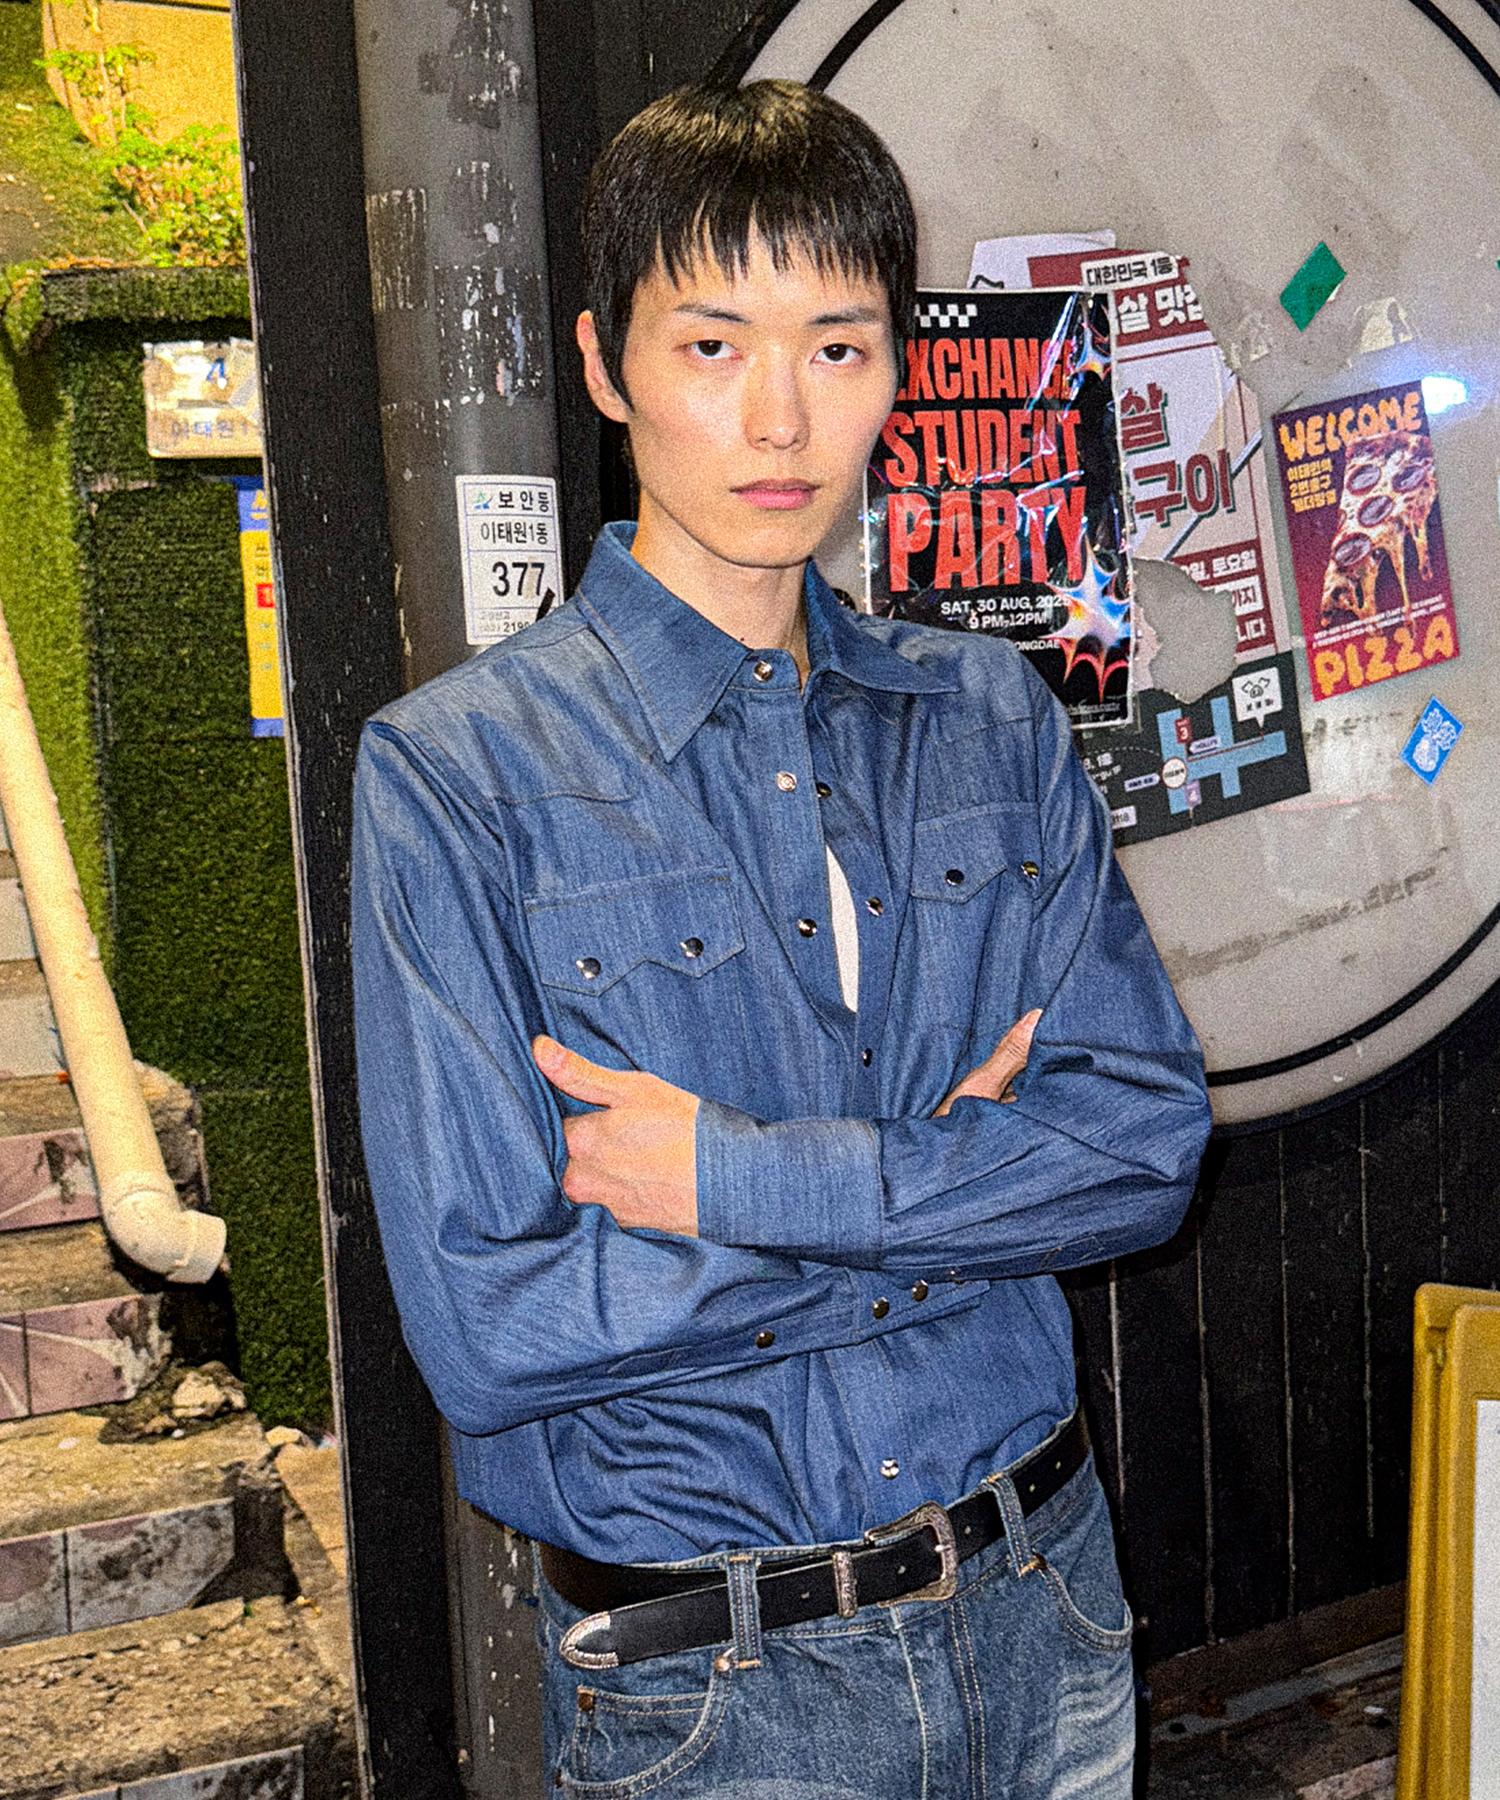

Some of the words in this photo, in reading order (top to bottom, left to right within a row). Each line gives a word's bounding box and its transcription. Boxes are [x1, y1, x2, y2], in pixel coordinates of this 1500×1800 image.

[1086, 260, 1148, 286] 대한민국
[1150, 256, 1173, 277] 1등
[1118, 292, 1150, 334] 살
[1120, 382, 1169, 454] 살
[1279, 391, 1422, 462] WELCOME
[881, 408, 1082, 488] STUDENT
[480, 521, 549, 545] 이태원1동
[887, 486, 1087, 592] PARTY
[492, 561, 545, 597] 377
[1212, 548, 1258, 578] 토요일
[976, 598, 998, 612] 30
[1000, 596, 1034, 611] AUG,
[969, 616, 979, 630] 9
[1314, 614, 1455, 696] PIZZA
[1179, 726, 1189, 740] 3
